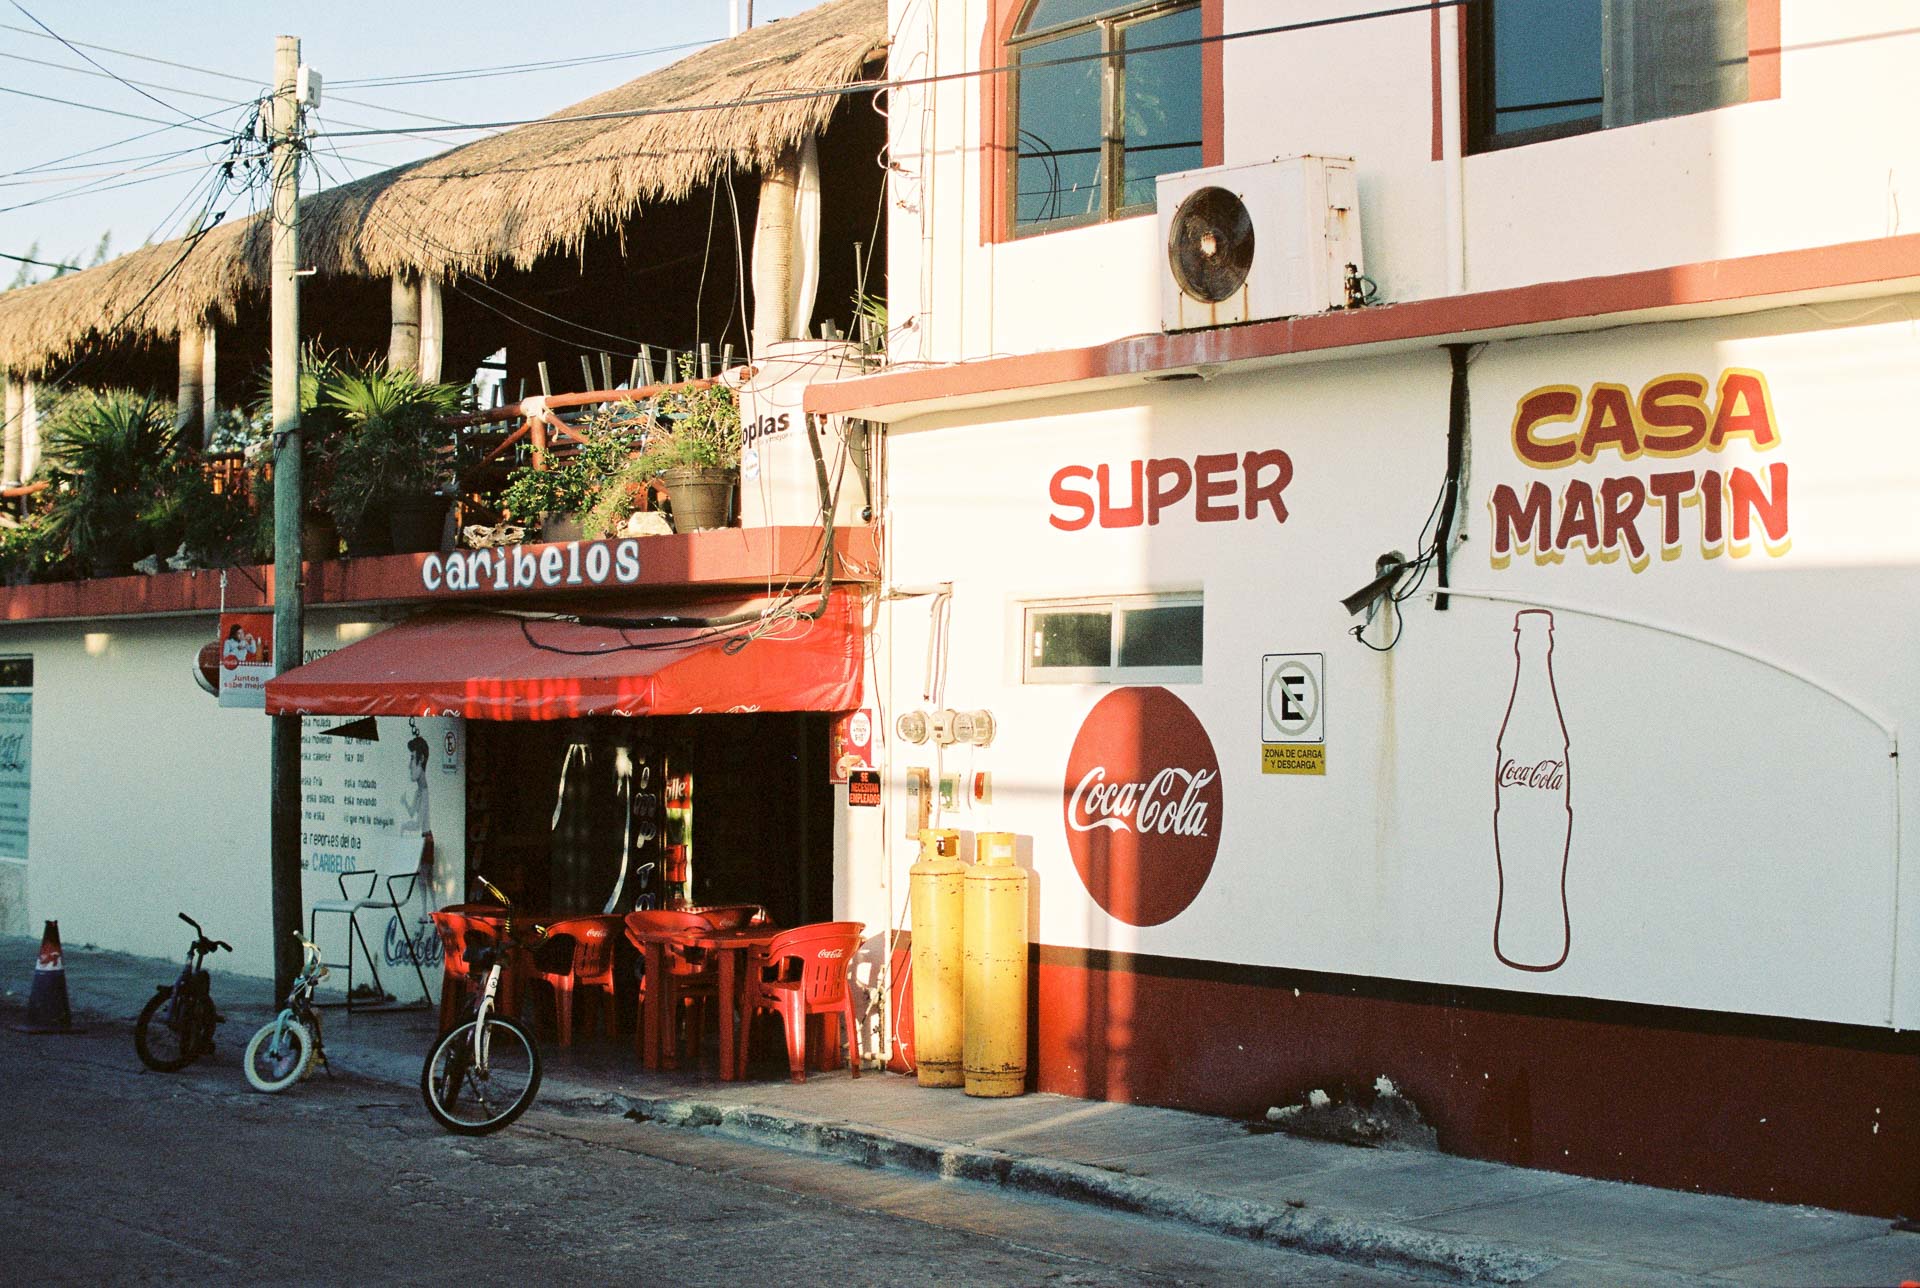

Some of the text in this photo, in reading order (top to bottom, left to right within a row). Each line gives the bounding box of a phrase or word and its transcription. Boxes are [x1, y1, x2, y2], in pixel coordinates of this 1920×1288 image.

[1511, 367, 1782, 470] CASA
[1049, 449, 1294, 532] SUPER
[1487, 462, 1792, 575] MARTIN
[422, 539, 641, 591] caribelos
[244, 682, 265, 691] mejo
[1281, 676, 1304, 721] E
[1264, 748, 1322, 759] ZONA DE CARGA
[1270, 760, 1316, 769] Y DESCARGA
[1500, 759, 1564, 790] Coca-Cola
[850, 782, 879, 793] NECESITAN
[861, 772, 869, 782] SE
[849, 793, 880, 804] EMPLEADOS
[1068, 766, 1217, 836] Coca-Cola
[309, 832, 339, 848] reportes
[339, 832, 350, 849] del
[312, 852, 356, 873] CARIBELOS
